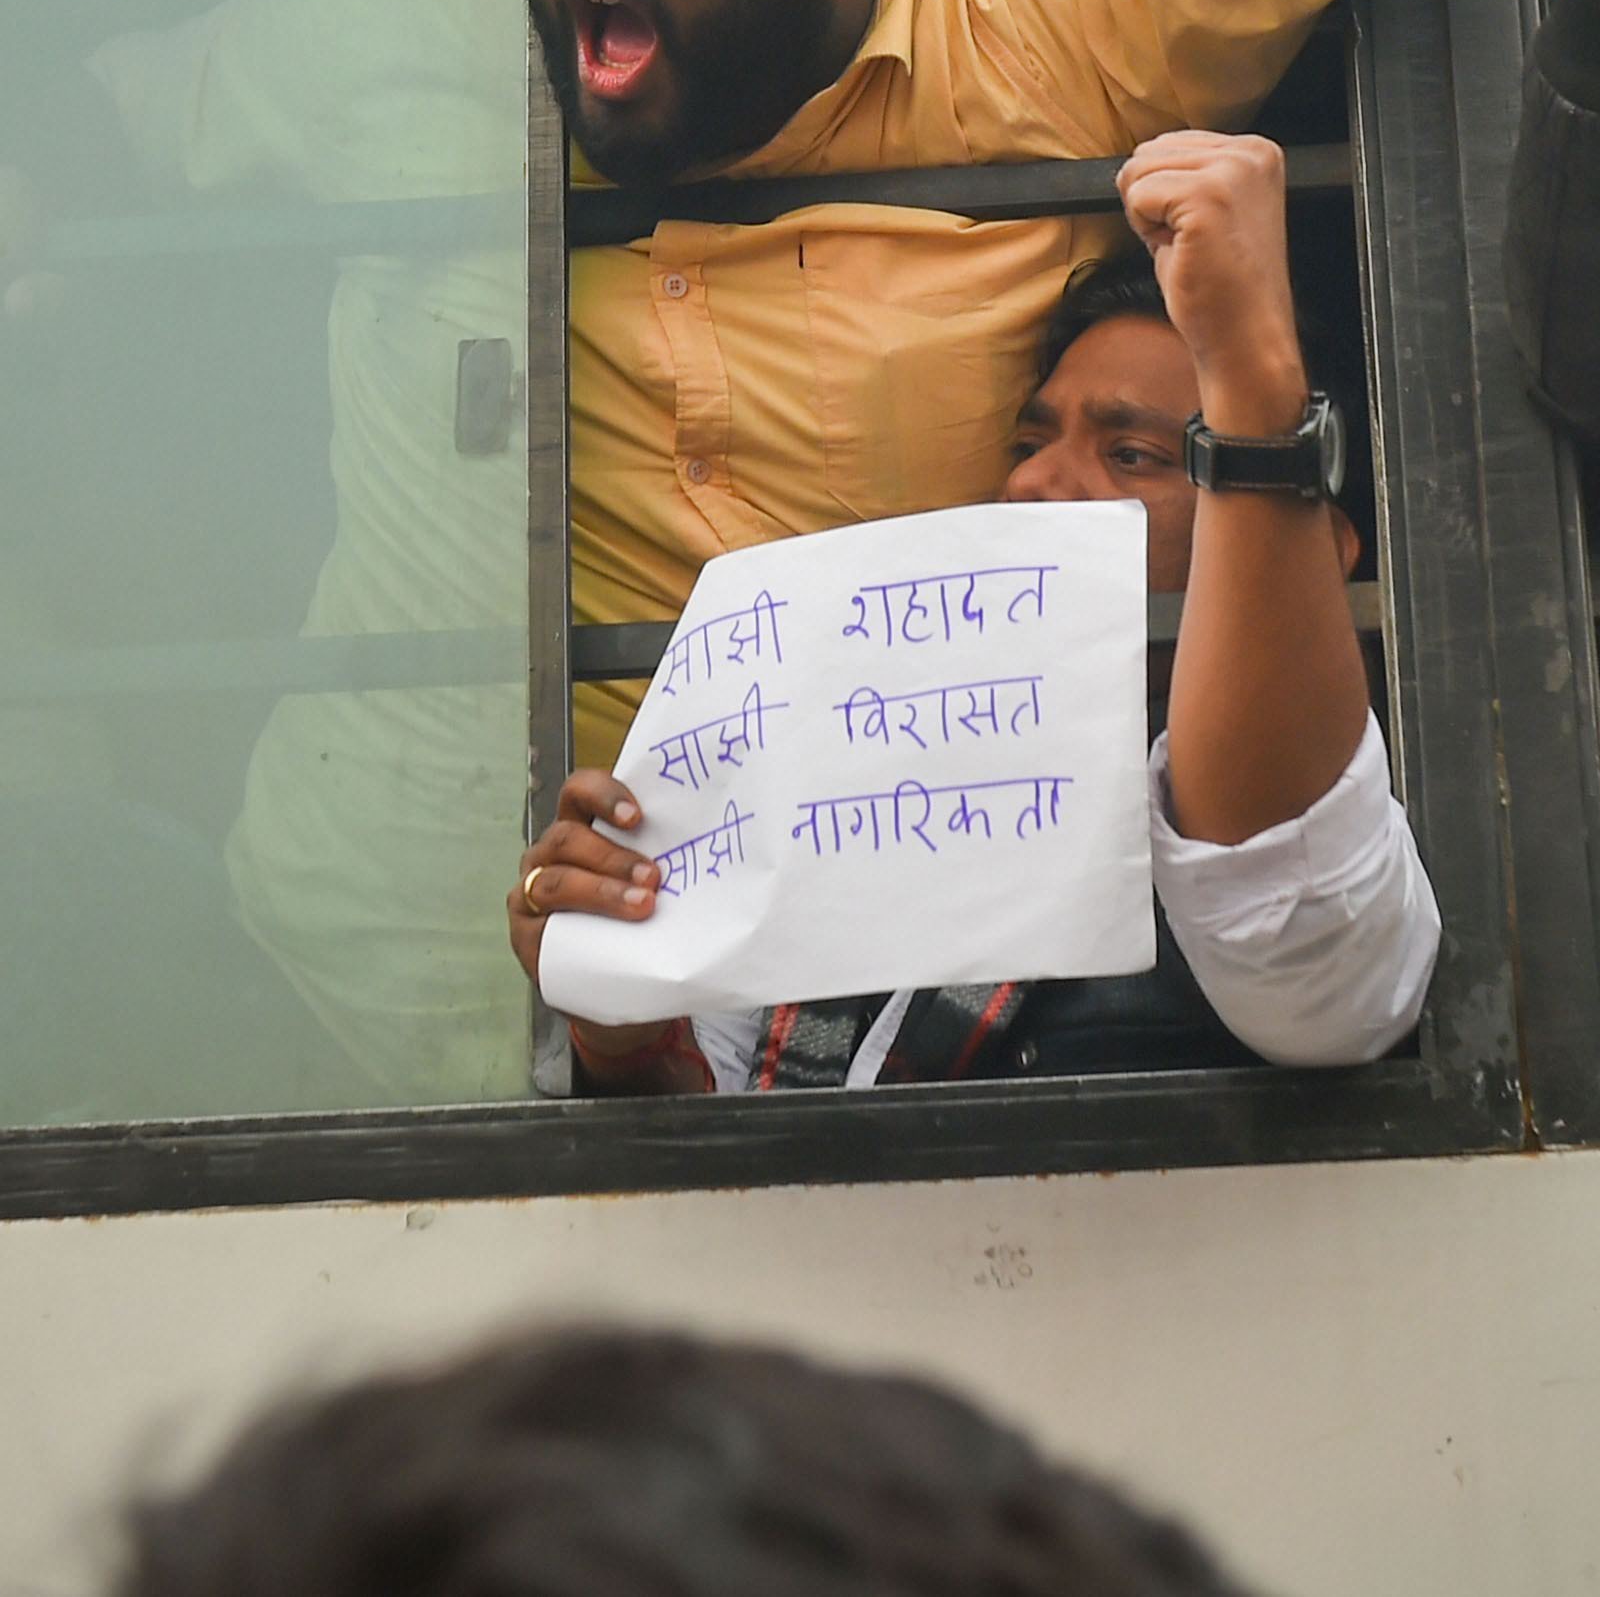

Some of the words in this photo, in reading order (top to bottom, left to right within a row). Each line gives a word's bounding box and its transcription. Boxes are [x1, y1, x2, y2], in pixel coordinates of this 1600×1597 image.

[842, 565, 1059, 646] शहादत
[649, 681, 789, 790] साझी
[832, 675, 1043, 749] विरासत
[654, 799, 754, 897] साझी
